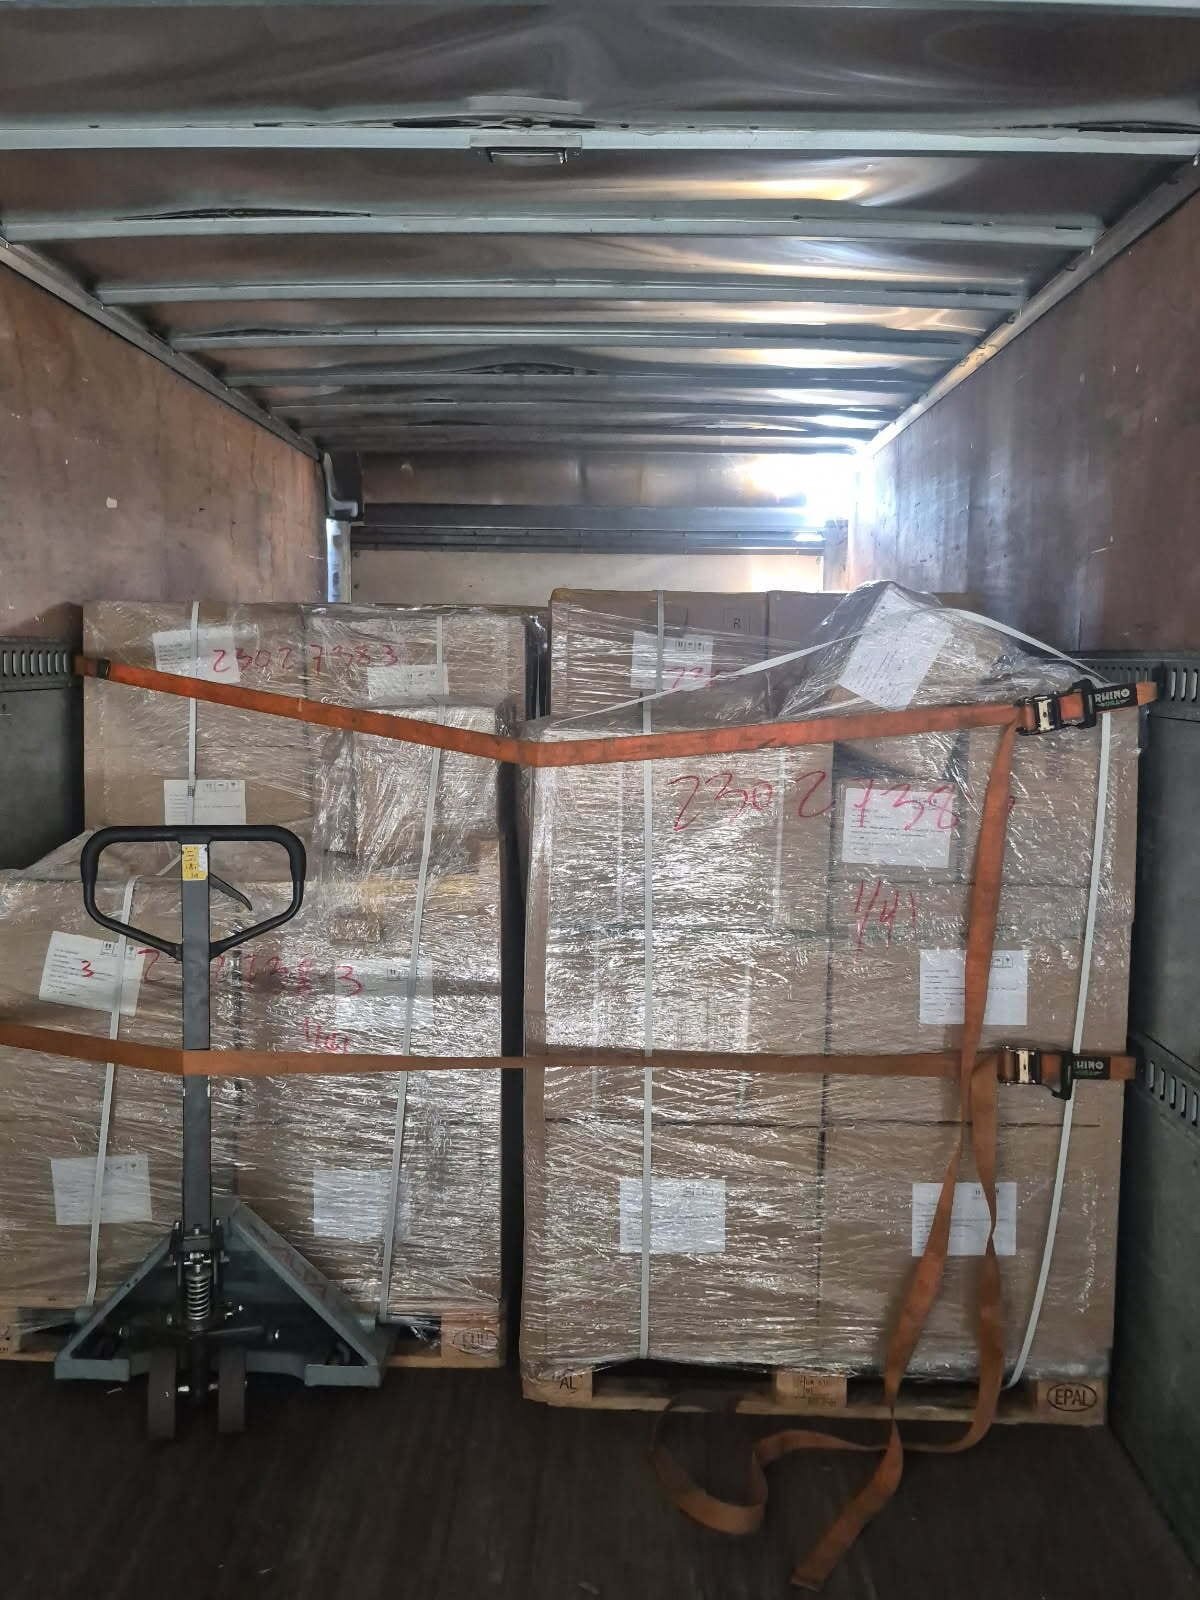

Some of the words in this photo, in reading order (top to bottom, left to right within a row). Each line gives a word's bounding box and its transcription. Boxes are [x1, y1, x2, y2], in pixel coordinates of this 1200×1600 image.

[1094, 688, 1130, 703] RHINO
[667, 769, 1016, 832] 2302738
[1055, 1388, 1088, 1406] EPAL
